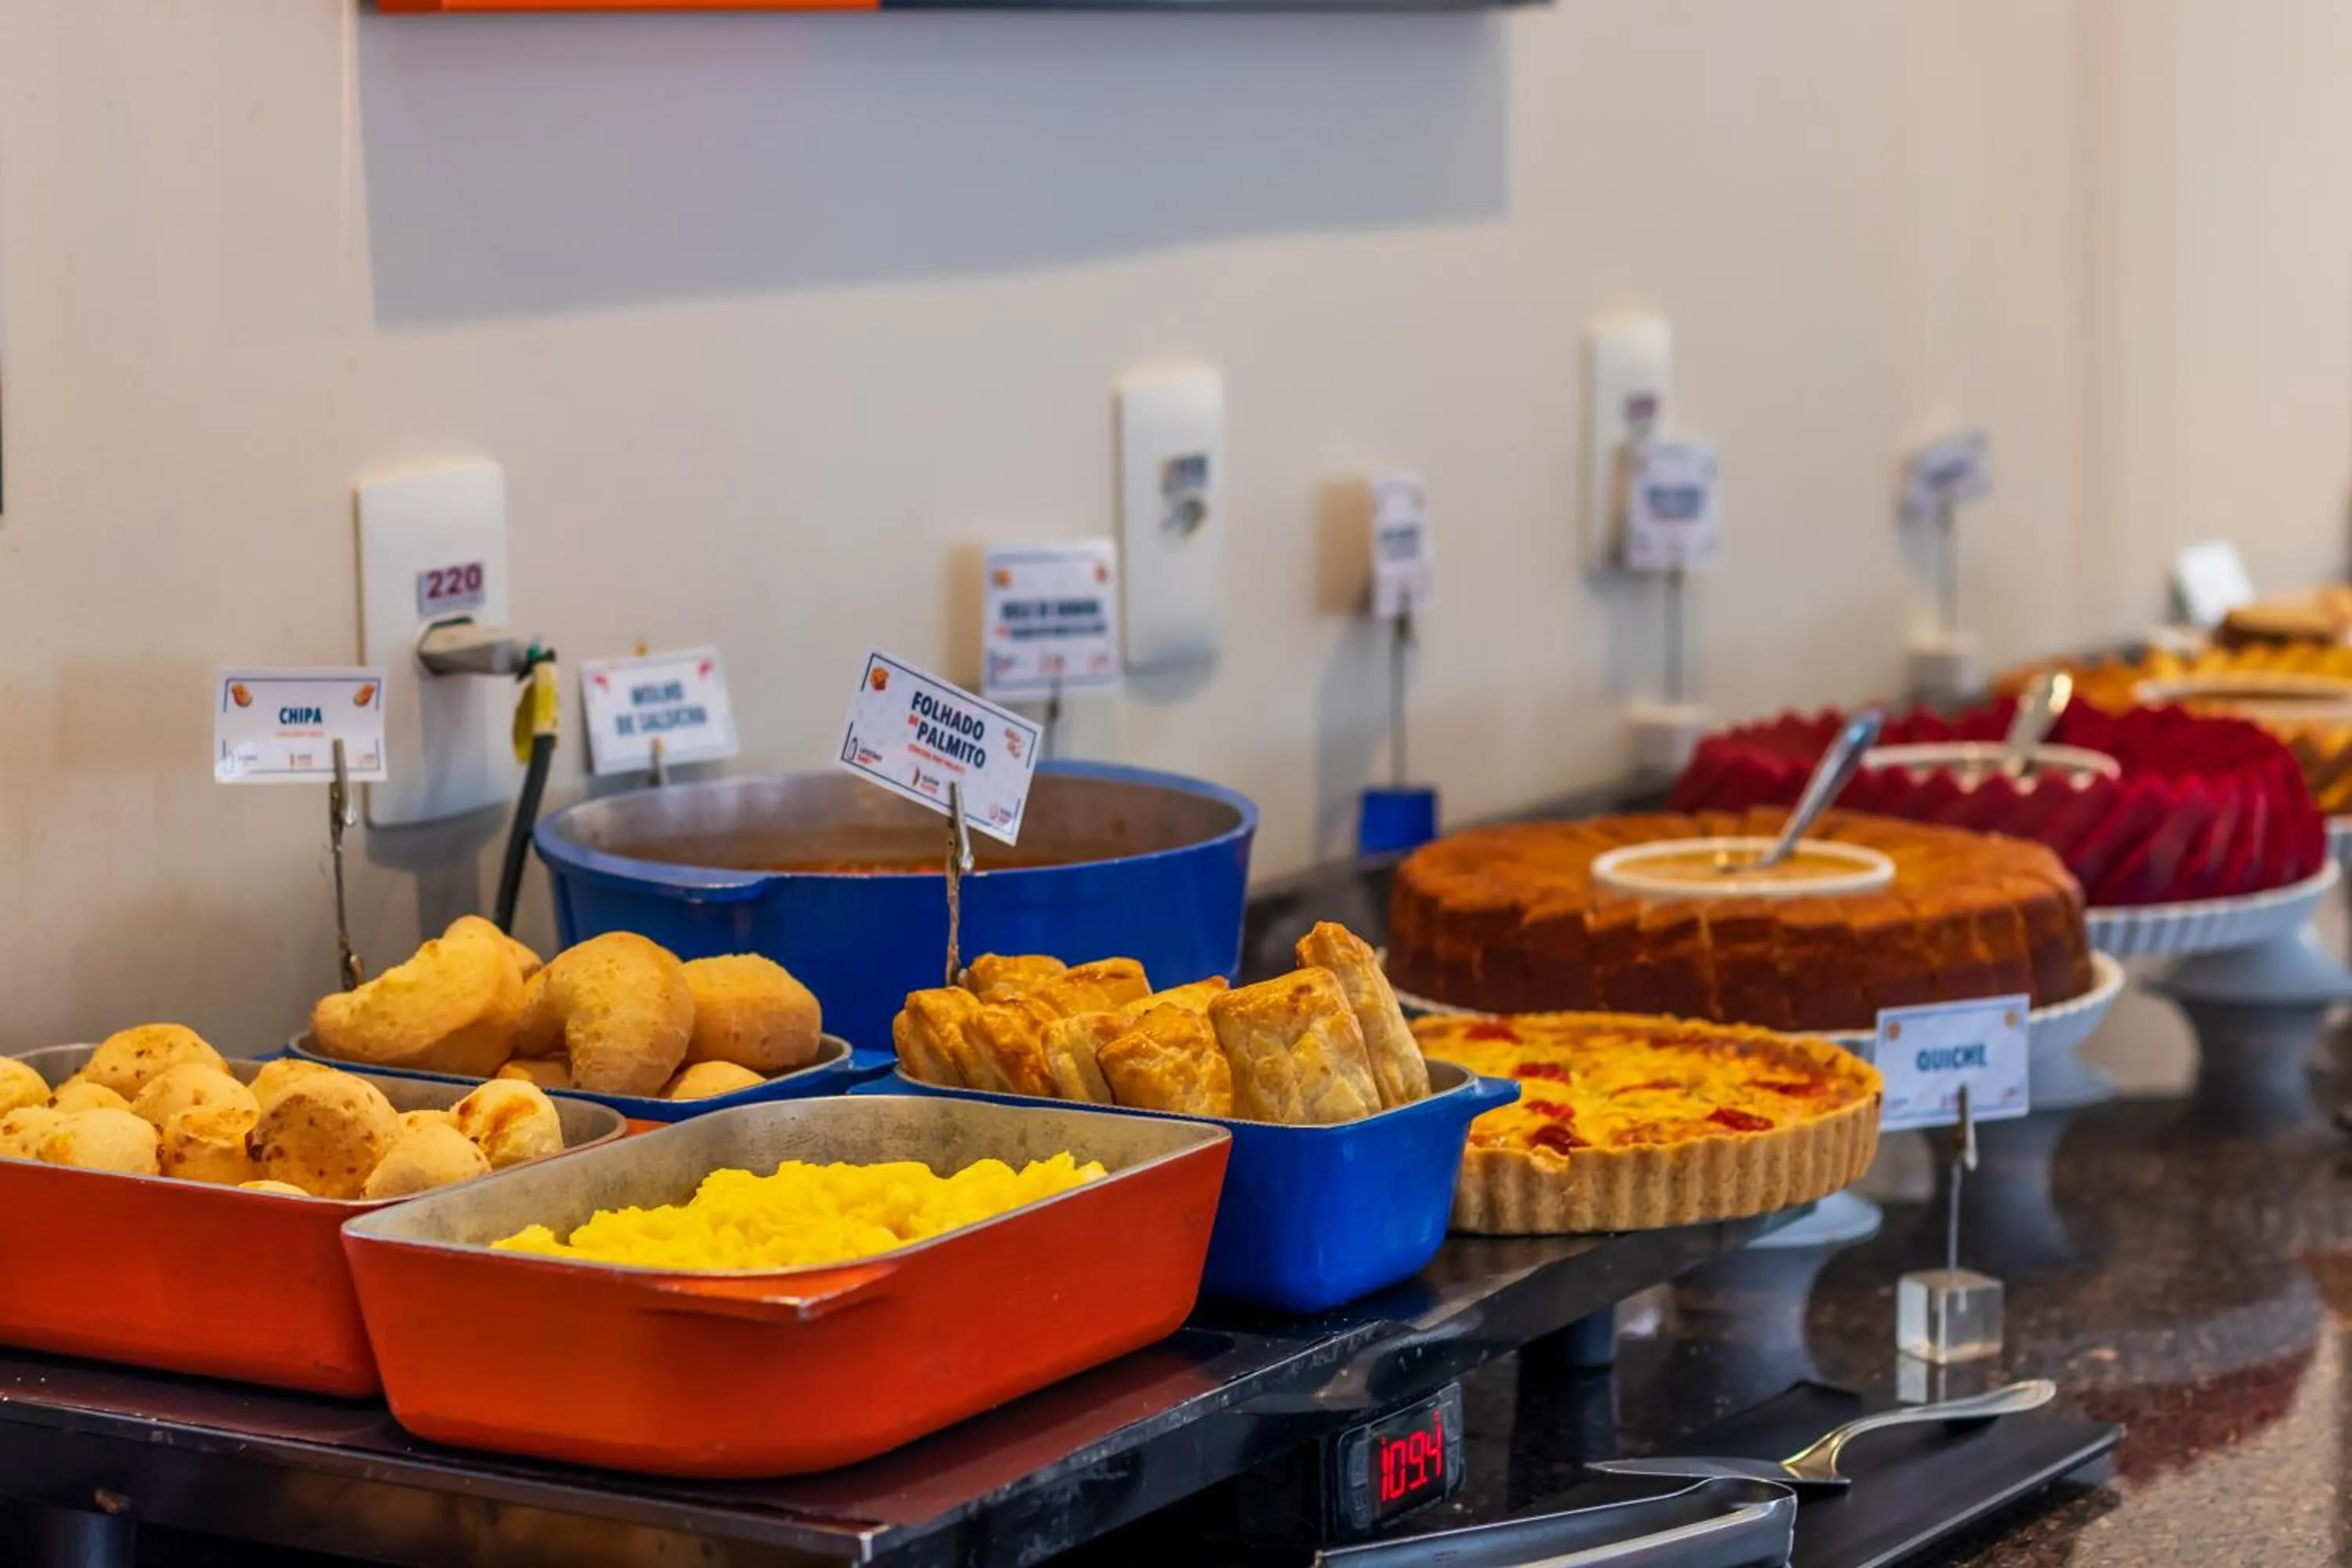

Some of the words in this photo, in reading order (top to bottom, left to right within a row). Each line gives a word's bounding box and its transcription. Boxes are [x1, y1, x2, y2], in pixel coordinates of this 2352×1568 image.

[428, 563, 483, 600] 220
[278, 706, 323, 724] CHIPA
[911, 691, 985, 741] FOLHADO
[916, 720, 986, 769] PALMITO
